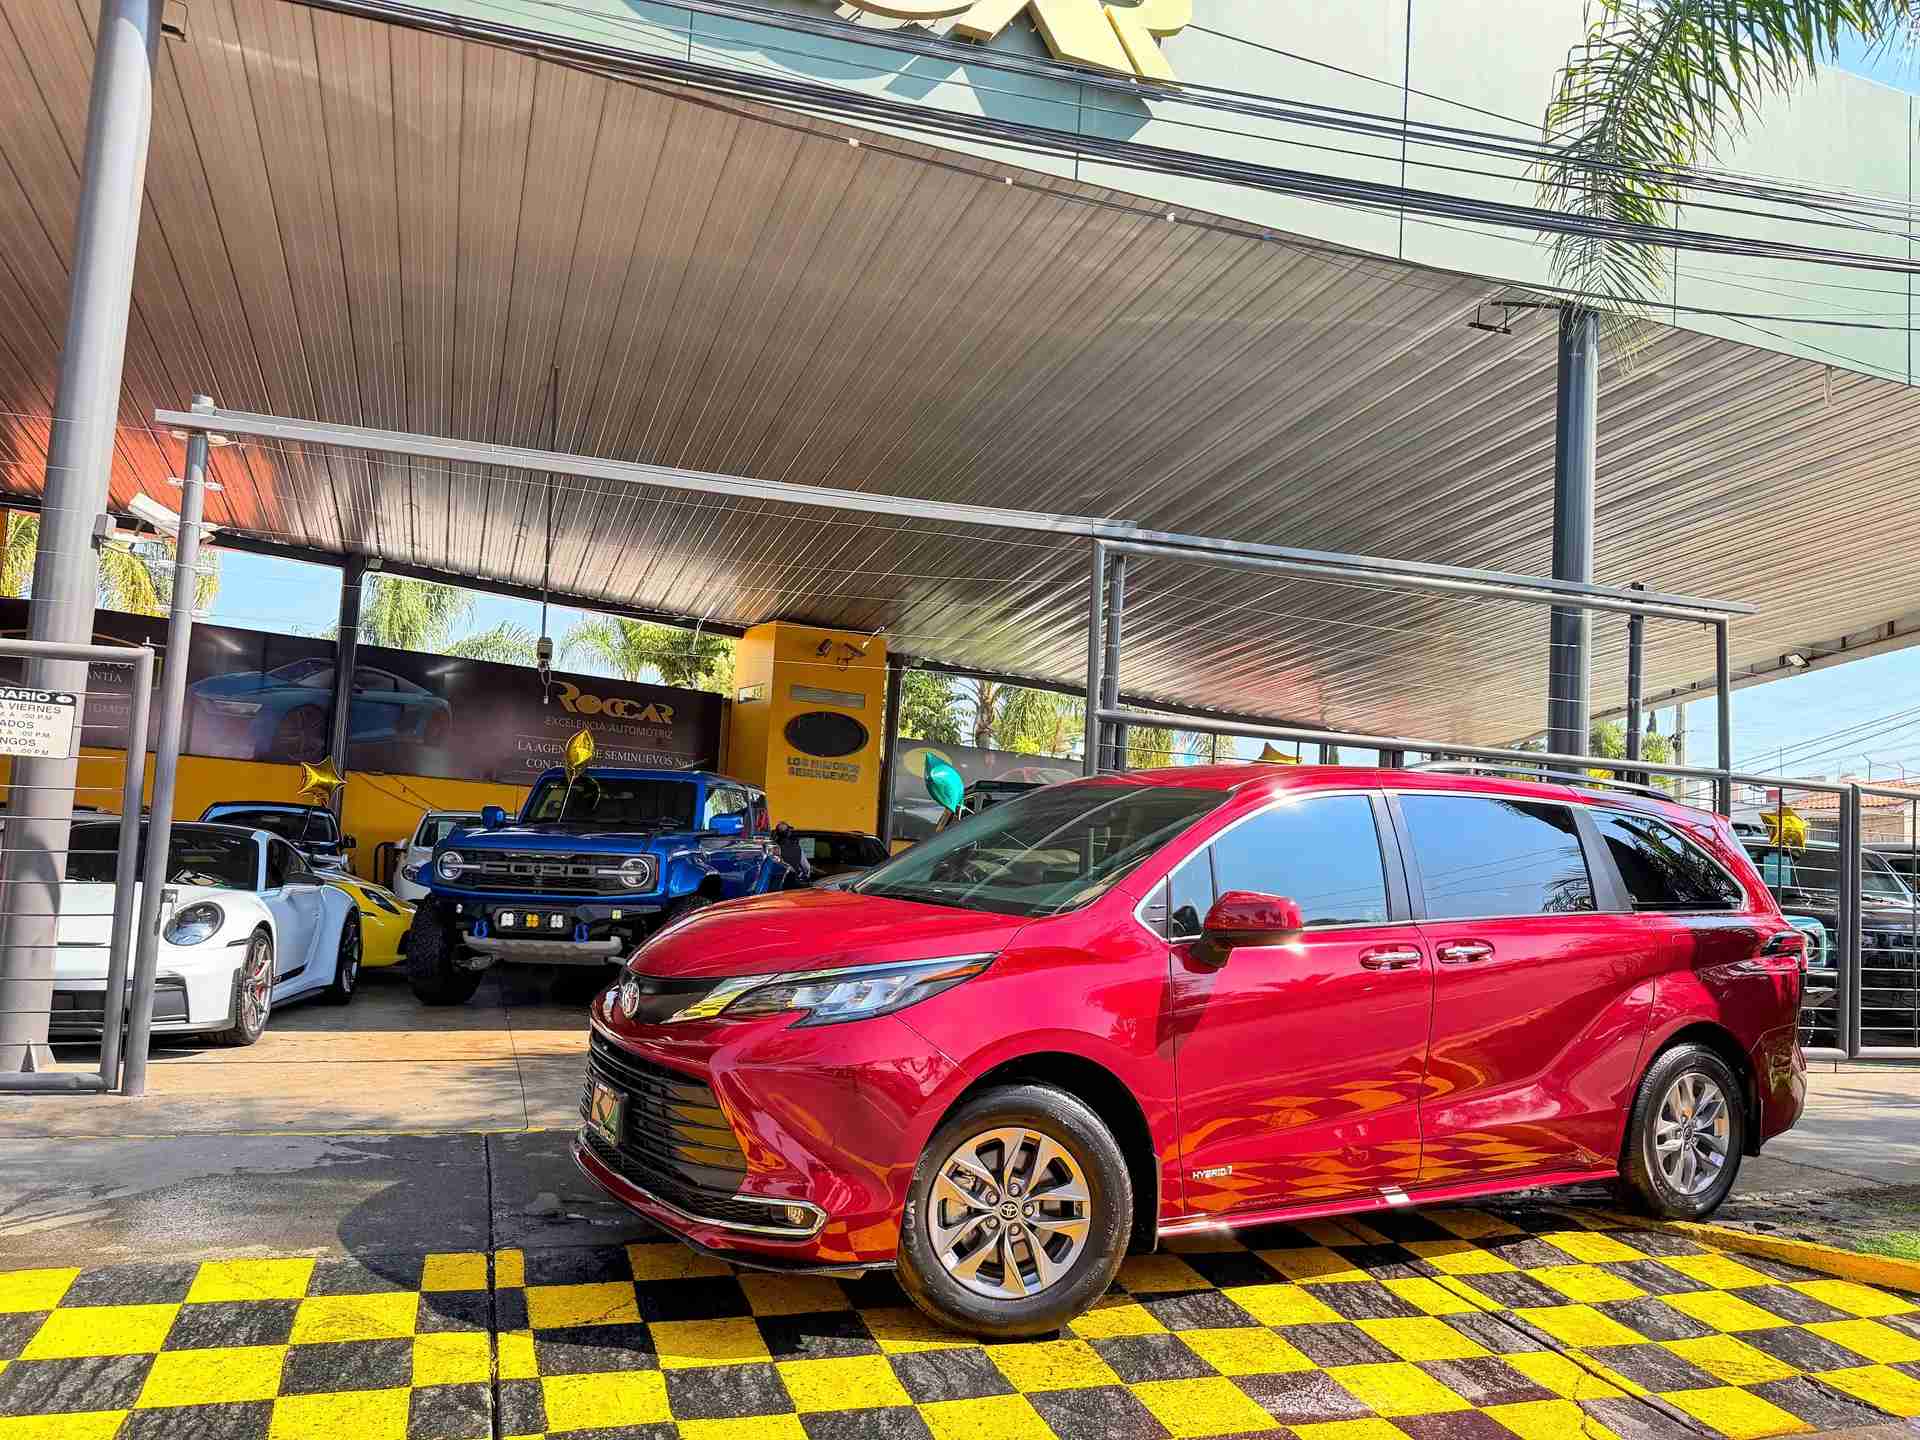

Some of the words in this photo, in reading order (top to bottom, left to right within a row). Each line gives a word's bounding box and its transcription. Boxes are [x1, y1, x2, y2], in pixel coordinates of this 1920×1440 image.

[8, 702, 62, 714] VIERNES
[543, 715, 608, 731] EXCELENCIA
[604, 751, 673, 767] SEMINUEVOS
